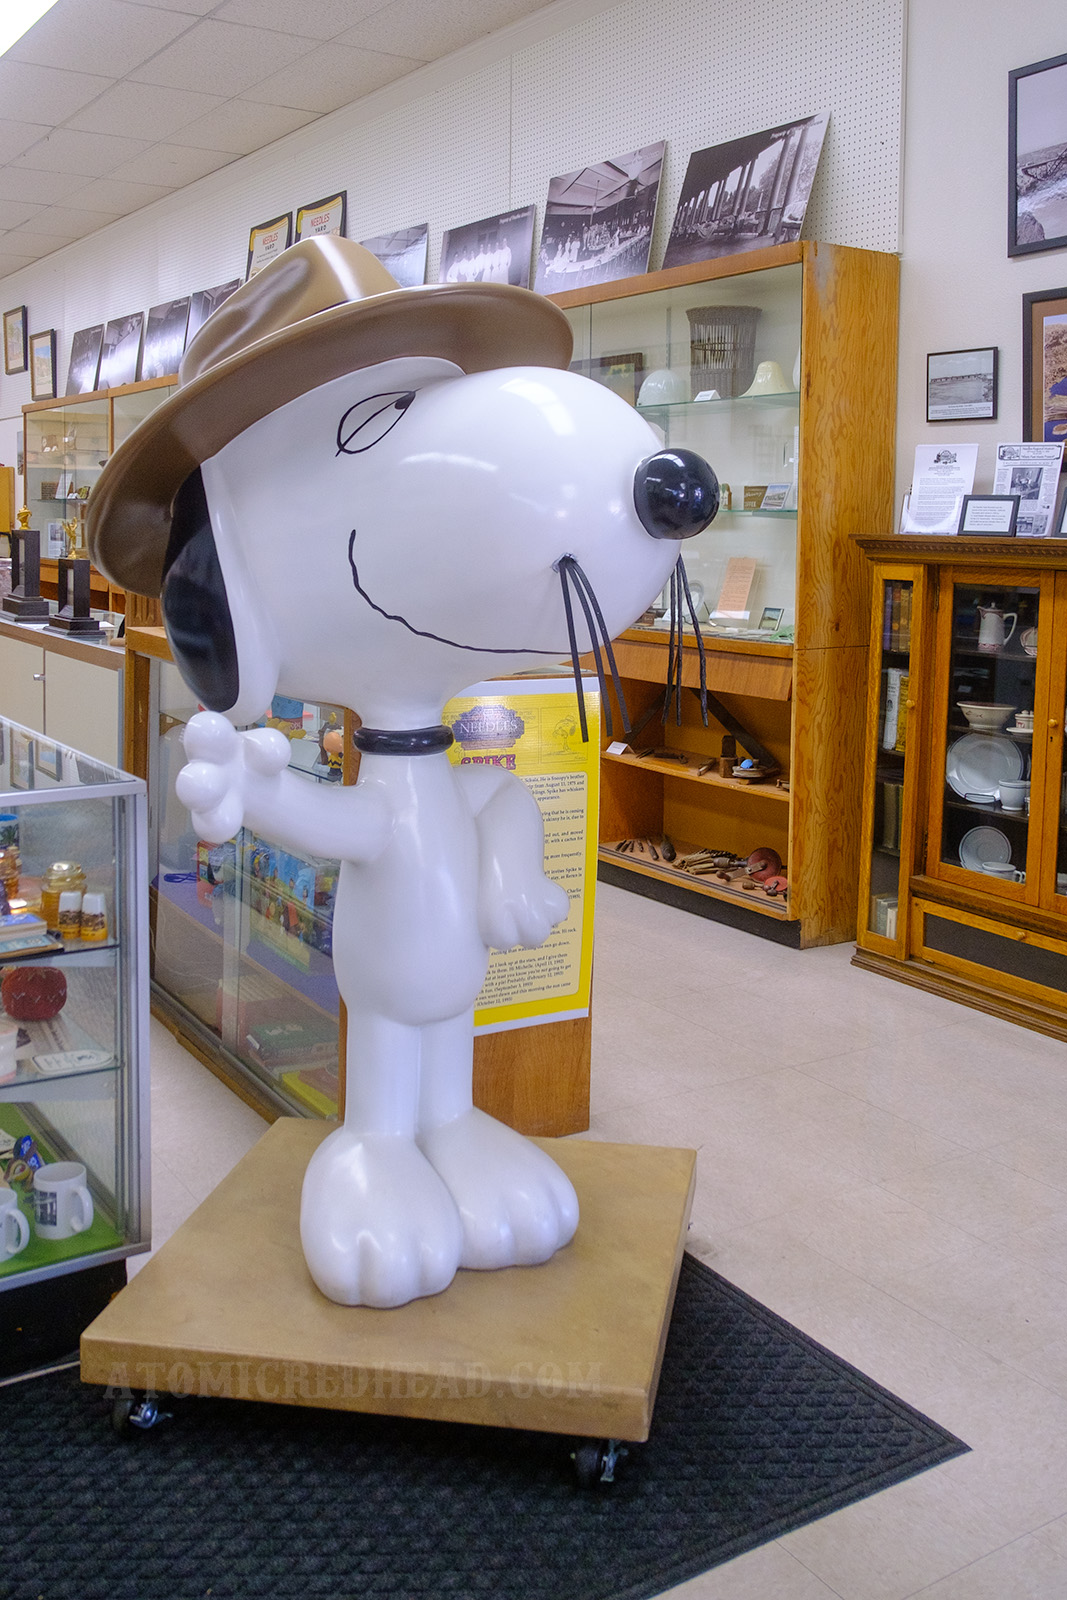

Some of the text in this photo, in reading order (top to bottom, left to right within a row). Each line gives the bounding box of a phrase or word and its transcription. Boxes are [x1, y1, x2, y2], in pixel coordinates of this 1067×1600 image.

[310, 213, 330, 227] NEEDLES
[315, 225, 326, 233] YARD
[262, 232, 278, 245] NEEDLES
[265, 243, 274, 251] YARD
[459, 720, 518, 734] NEEDLES
